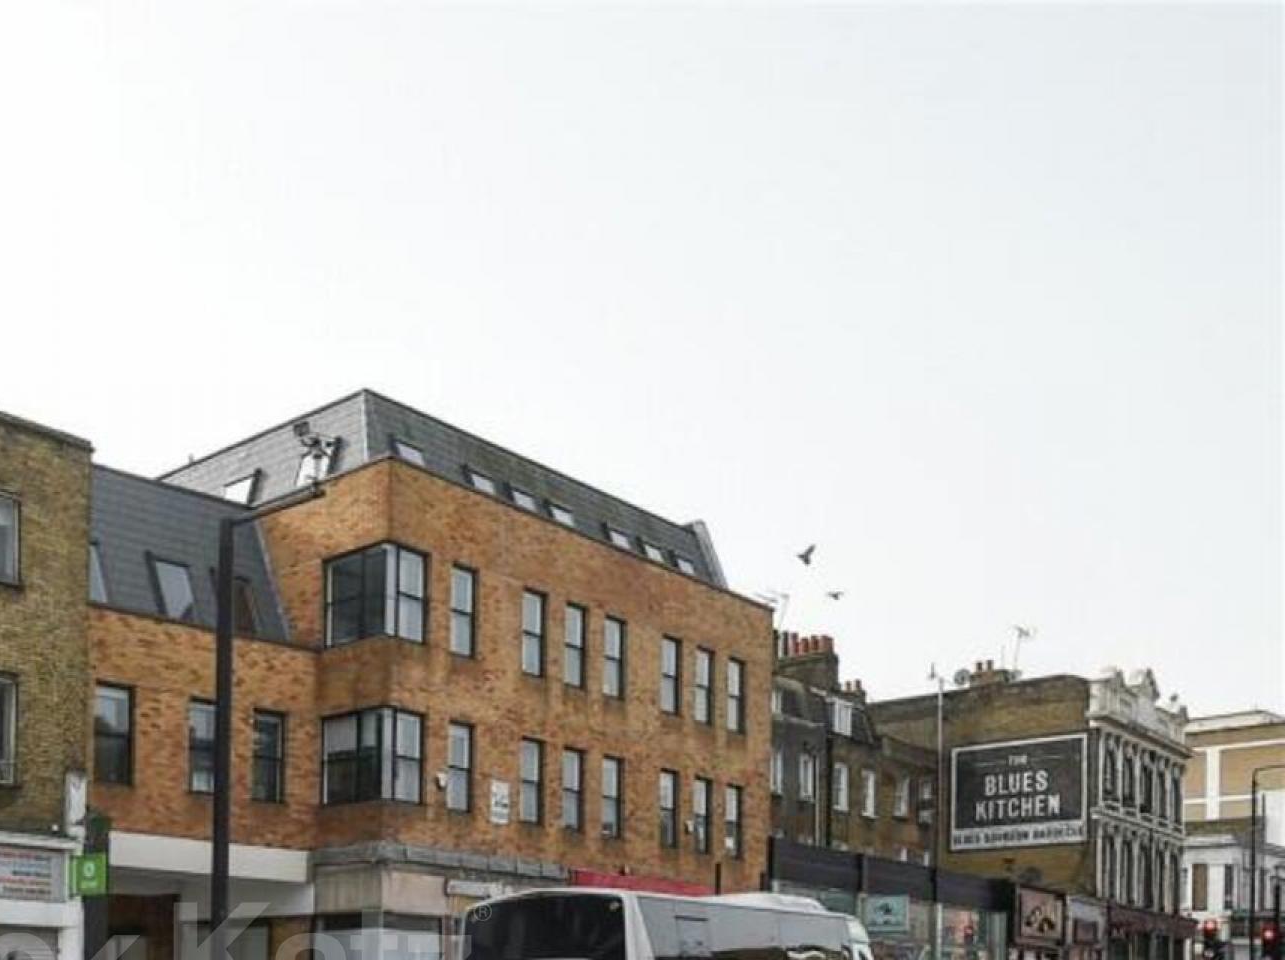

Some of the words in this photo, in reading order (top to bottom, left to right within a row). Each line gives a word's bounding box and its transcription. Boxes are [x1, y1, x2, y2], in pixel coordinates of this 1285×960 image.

[1008, 755, 1028, 766] THE
[984, 769, 1049, 796] BLUES
[975, 793, 1061, 822] KITCHEN
